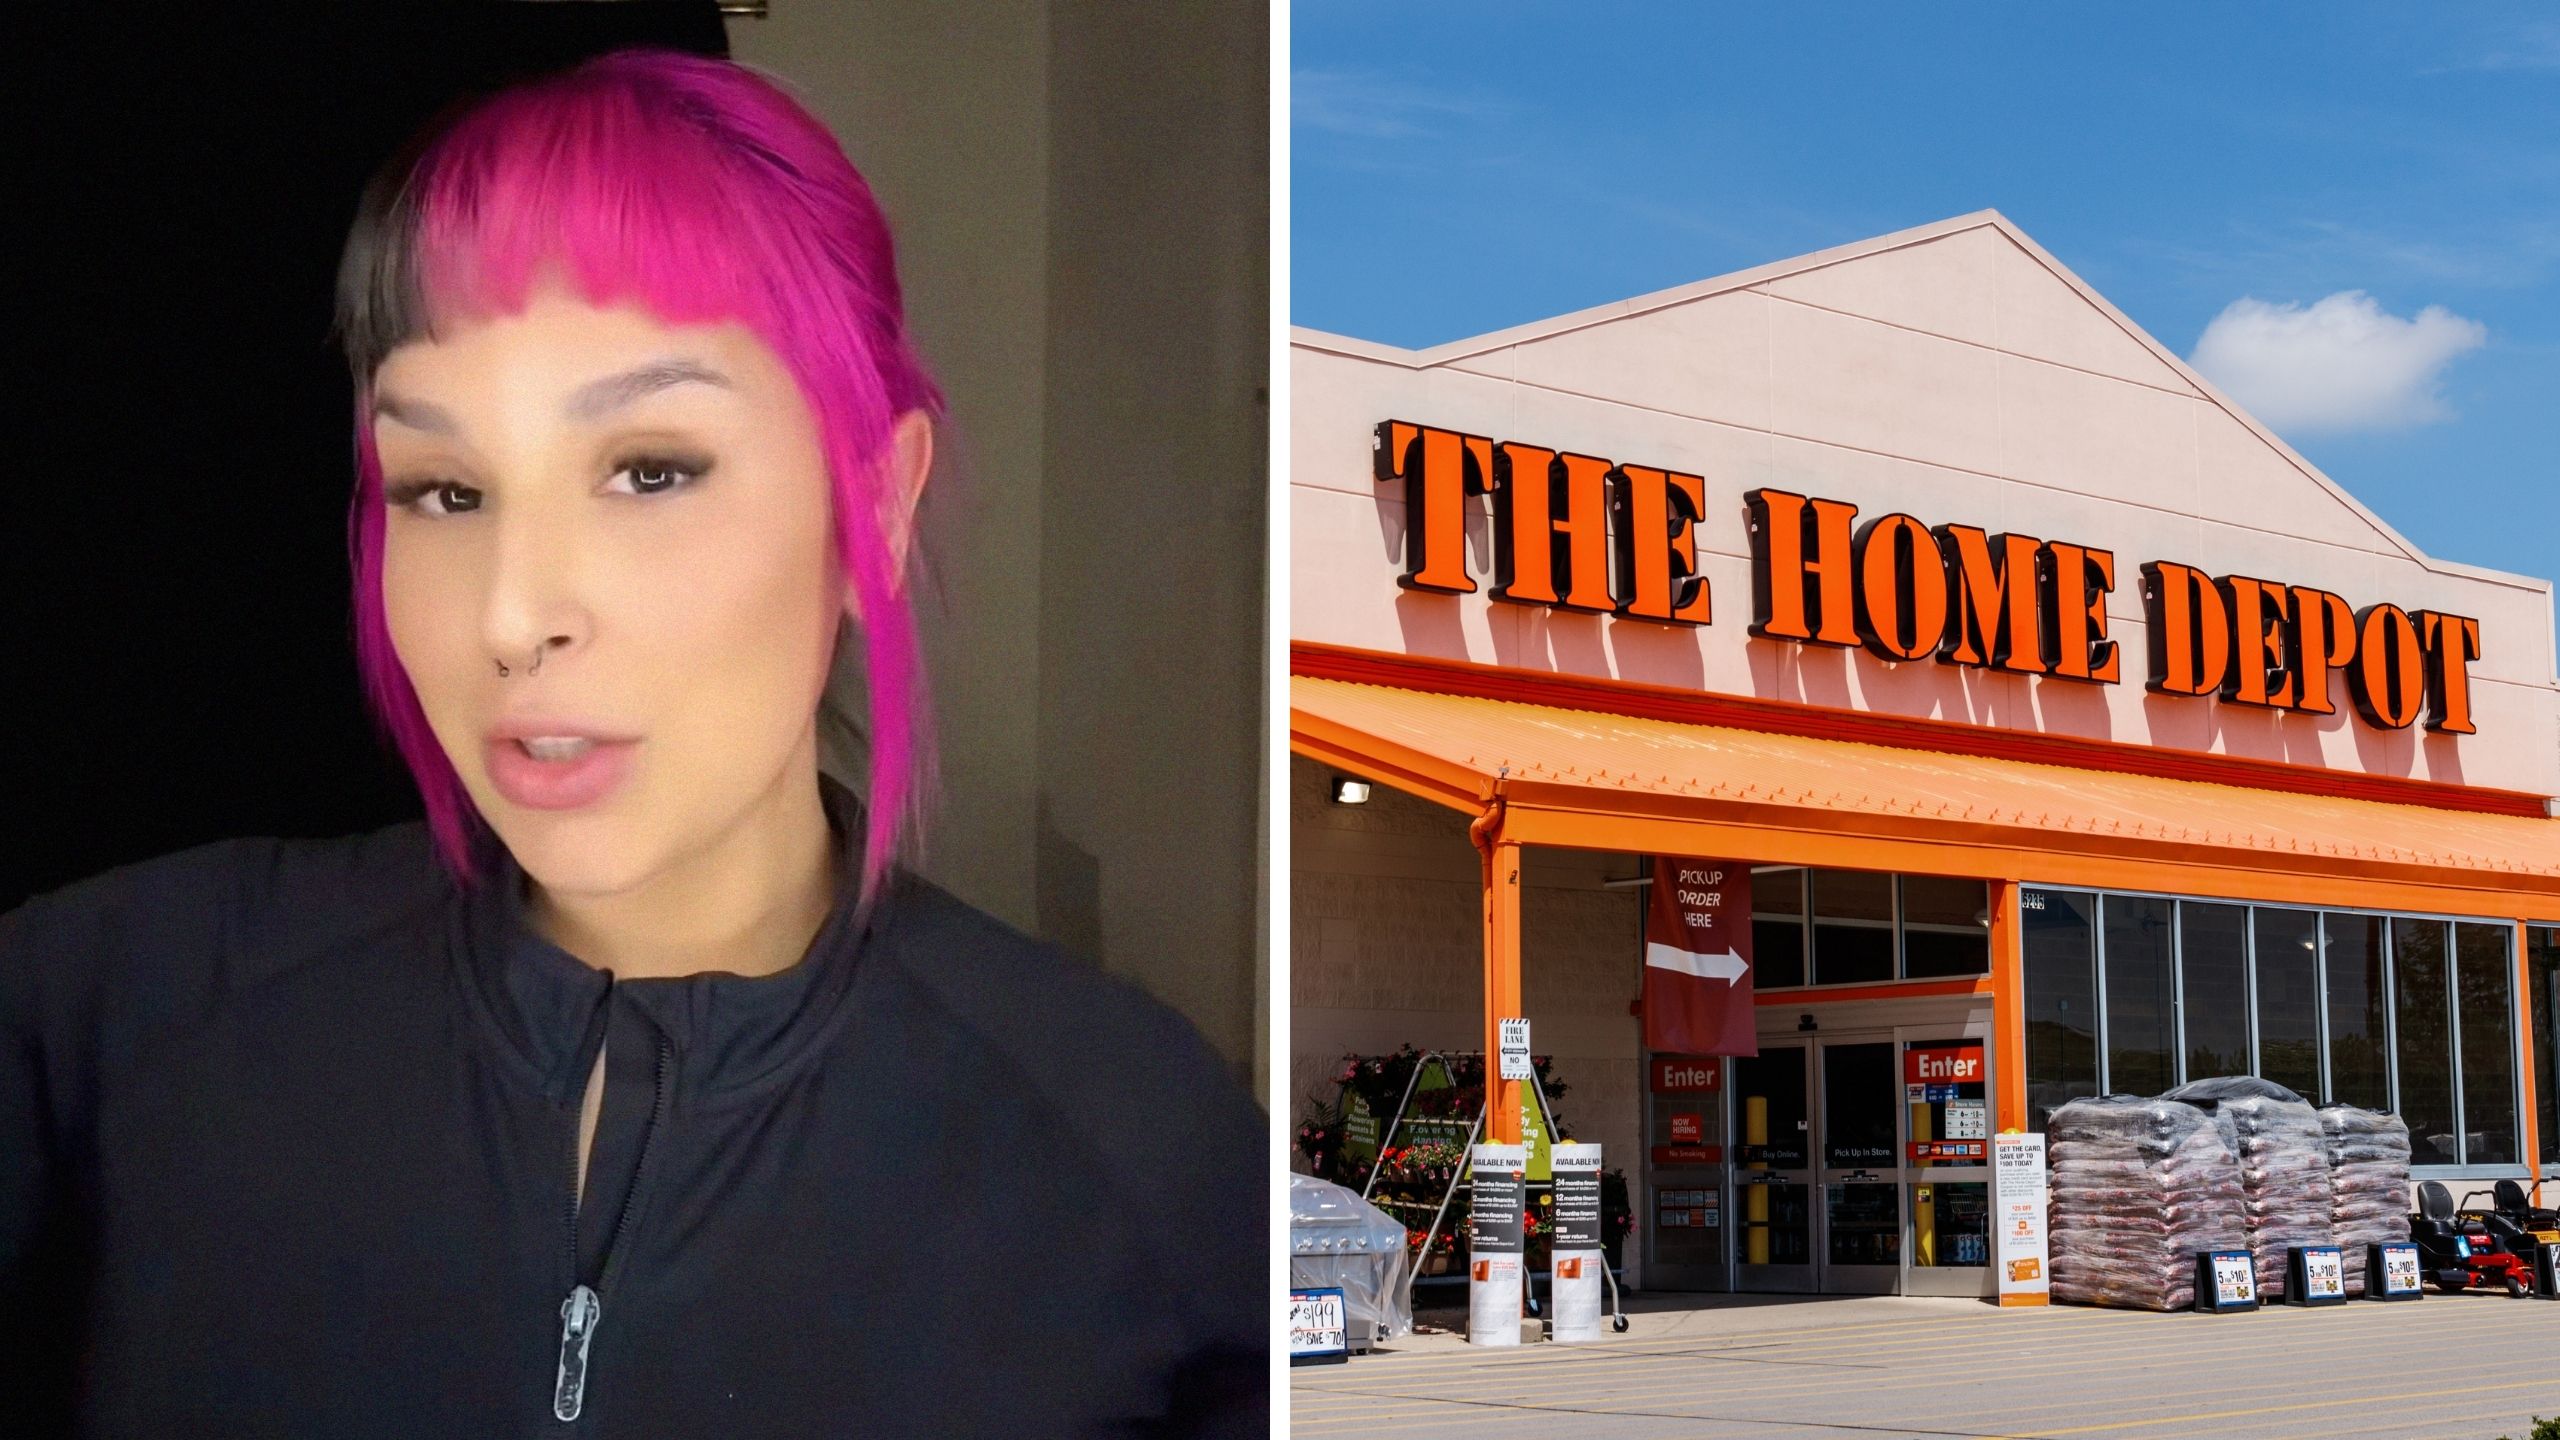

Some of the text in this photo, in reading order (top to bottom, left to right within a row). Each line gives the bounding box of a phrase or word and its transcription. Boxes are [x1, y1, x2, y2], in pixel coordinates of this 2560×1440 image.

[1373, 419, 2480, 735] THE HOME DEPOT
[1679, 869, 1723, 885] PICKUP
[1678, 889, 1721, 907] ORDER
[1684, 912, 1712, 928] HERE
[1505, 1026, 1525, 1035] FIRE
[1505, 1035, 1525, 1044] LANE
[1509, 1056, 1520, 1064] NO
[1918, 1054, 1977, 1078] Enter
[1664, 1065, 1715, 1087] Enter
[1672, 1118, 1690, 1126] NOW
[1672, 1126, 1697, 1134] HIRING
[1679, 1149, 1706, 1159] Smoking
[1762, 1150, 1776, 1159] Buy
[1835, 1148, 1850, 1157] Pick
[1851, 1148, 1861, 1157] Up
[1506, 1159, 1523, 1167] NOW
[1556, 1158, 1592, 1166] AVAILABLE
[1556, 1178, 1565, 1186] 24
[1556, 1193, 1564, 1201] 12
[1556, 1208, 1561, 1216] 6
[2310, 1265, 2315, 1278] 5
[2321, 1264, 2334, 1277] $10
[2388, 1262, 2394, 1274] 5
[2400, 1261, 2411, 1273] $10
[2218, 1271, 2224, 1284] 5
[2231, 1270, 2244, 1283] $10
[1303, 1302, 1335, 1328] $199
[1306, 1331, 1324, 1345] SAVE
